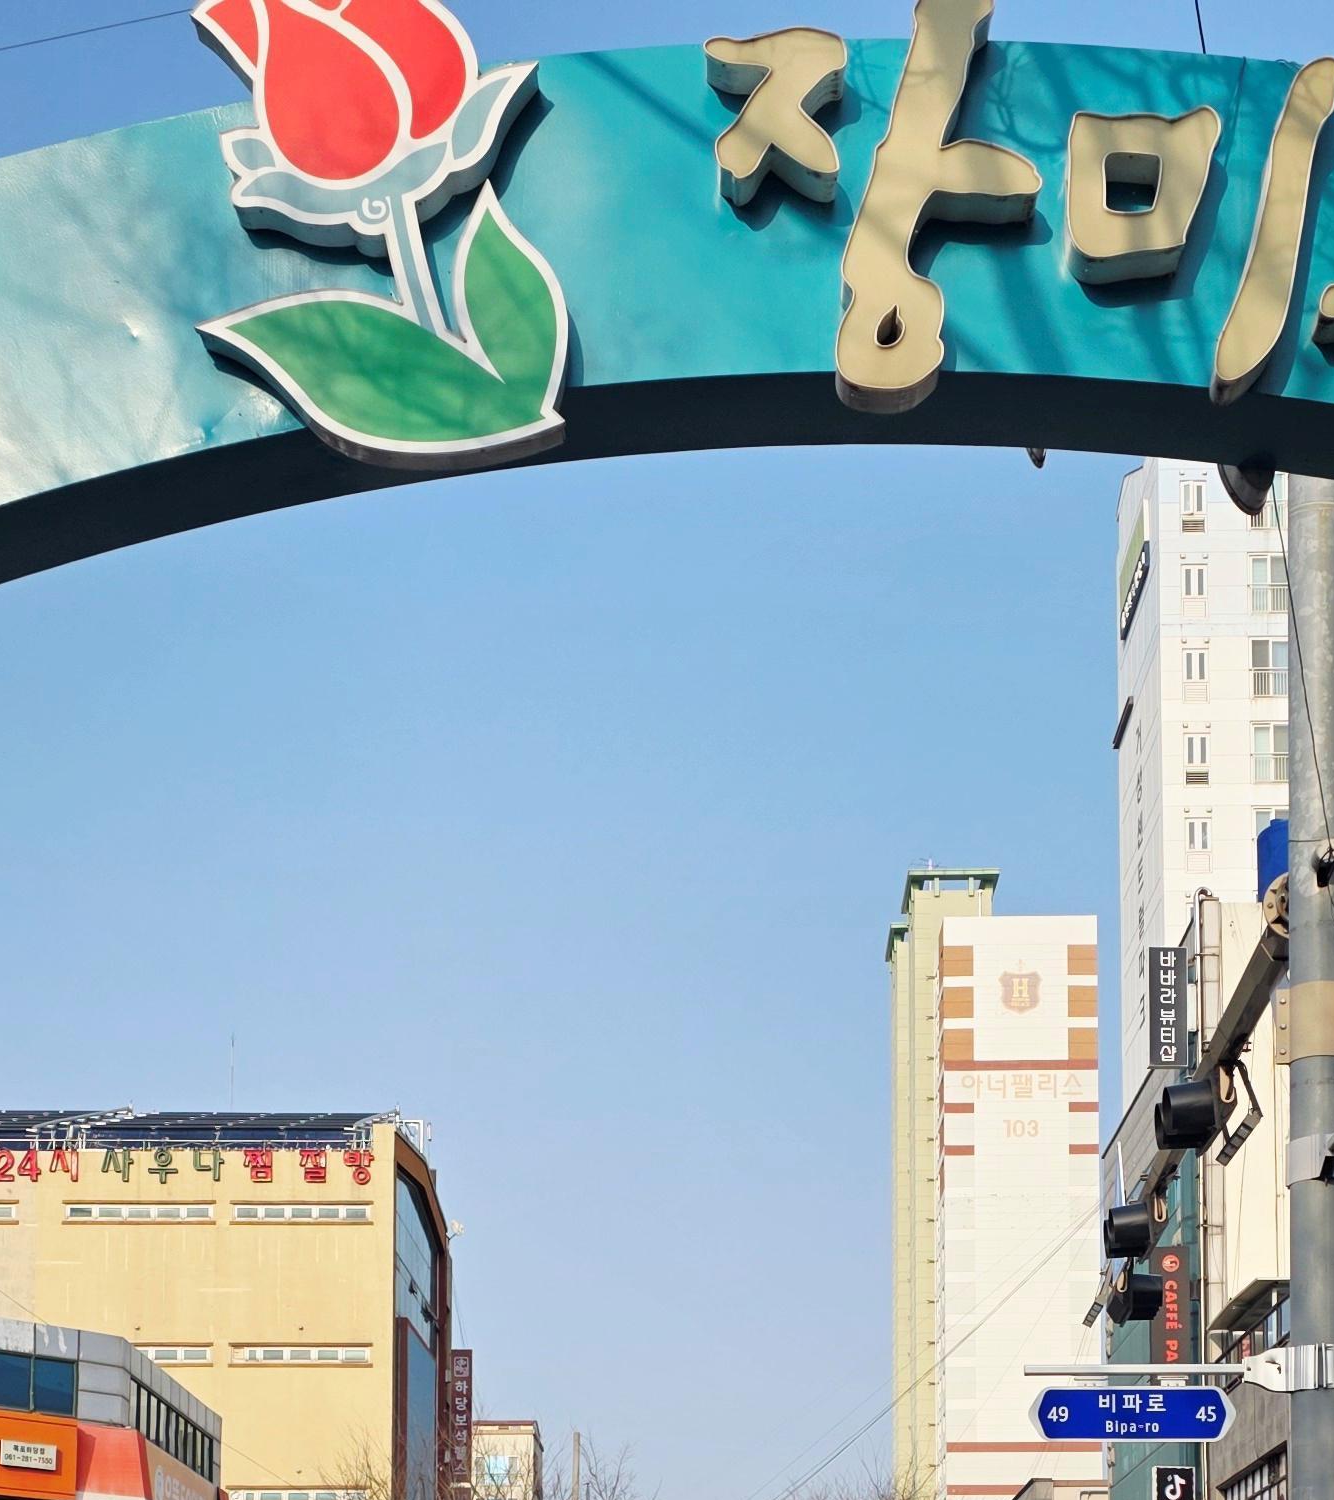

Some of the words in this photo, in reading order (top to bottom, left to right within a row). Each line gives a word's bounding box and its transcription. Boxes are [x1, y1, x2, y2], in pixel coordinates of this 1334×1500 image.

[961, 1073, 1084, 1100] 아너팰리스
[1003, 1119, 1040, 1138] 103
[101, 1148, 224, 1184] 사우나
[243, 1148, 375, 1185] 찜질방
[1047, 1407, 1069, 1423] 49
[1098, 1394, 1167, 1414] 비파로
[1195, 1406, 1217, 1422] 45
[1106, 1421, 1160, 1435] Bipa-ro
